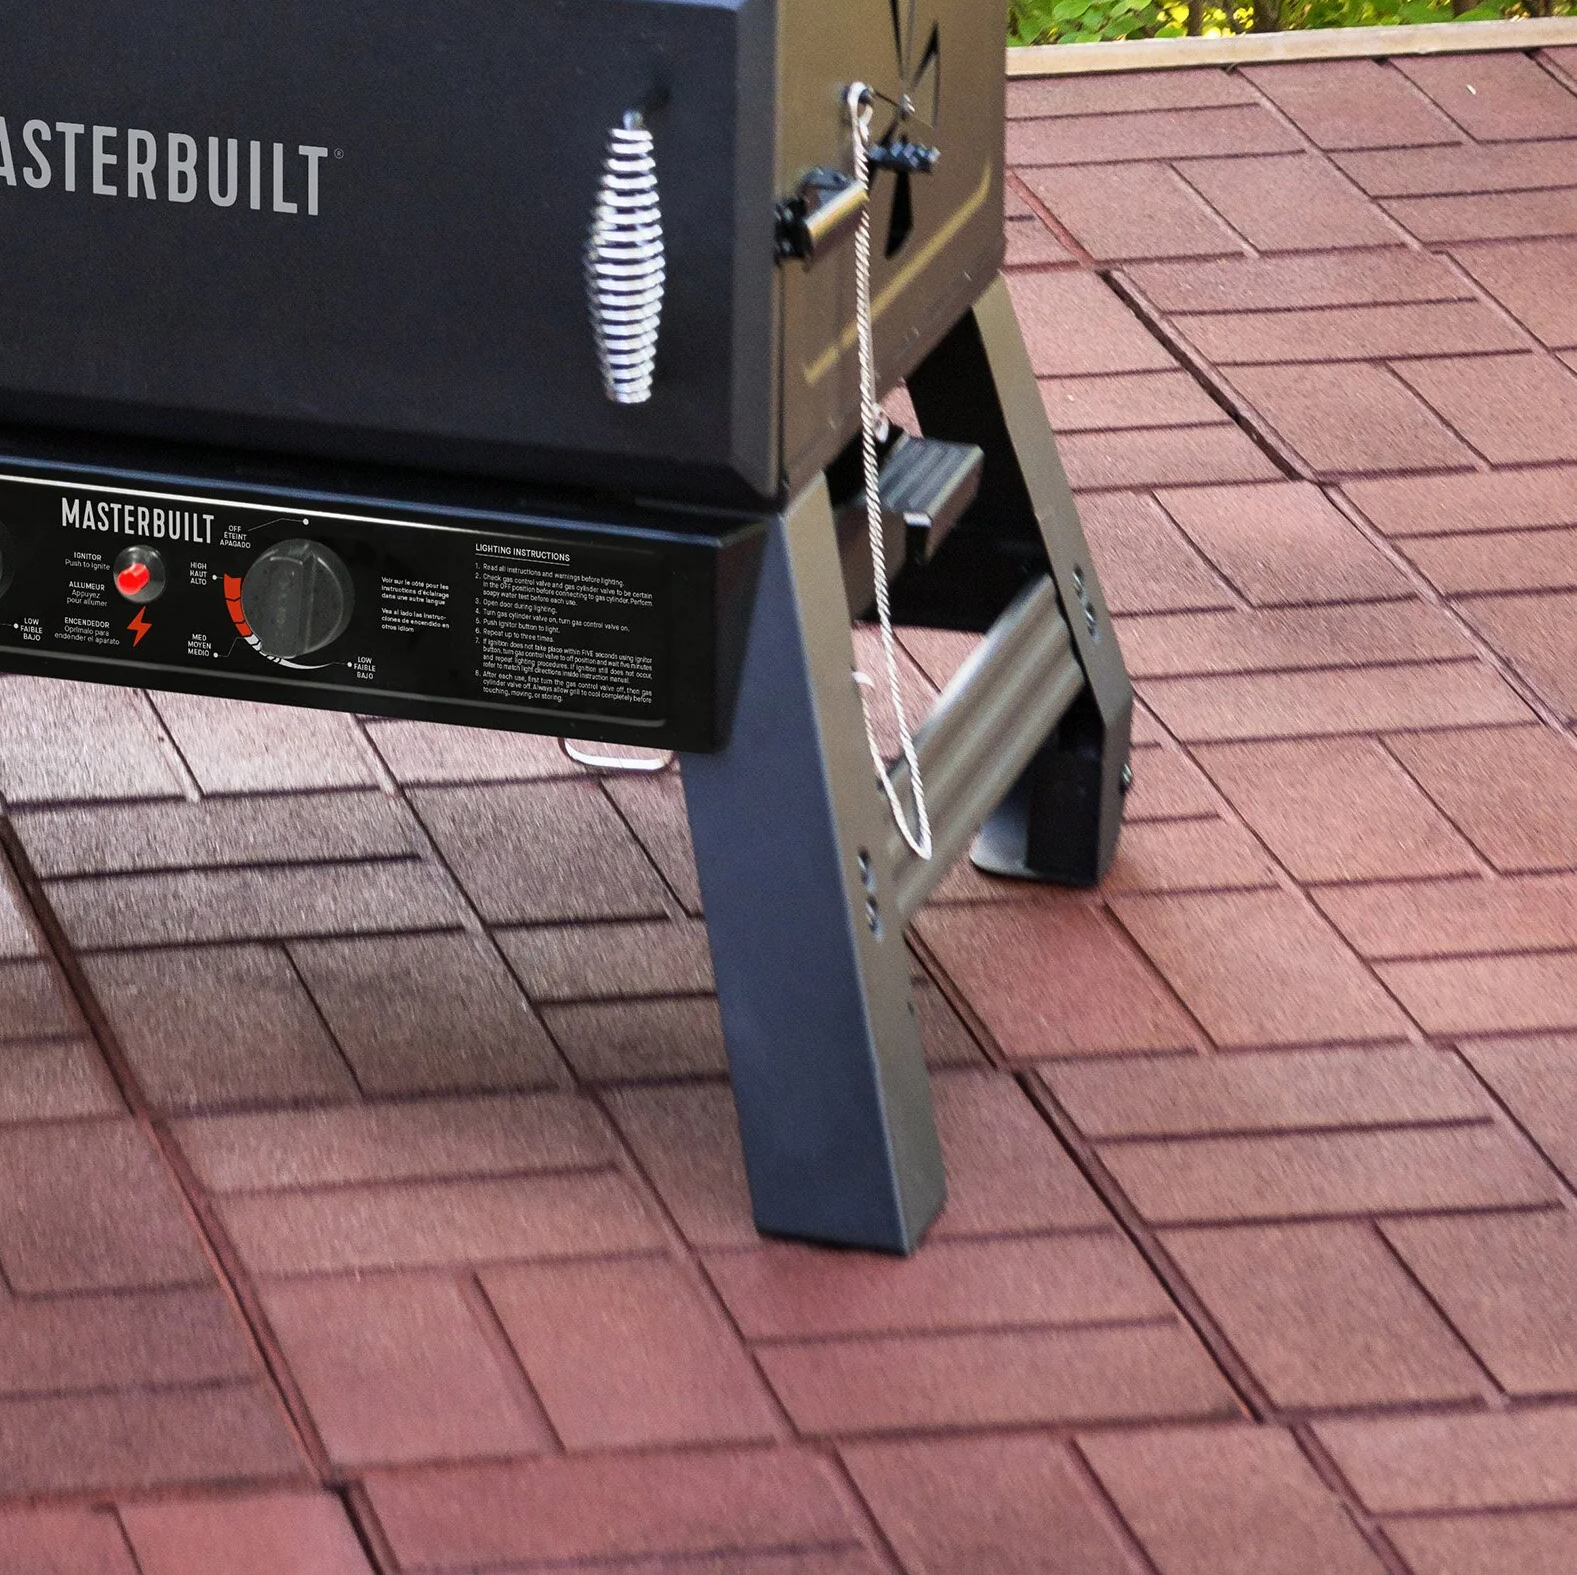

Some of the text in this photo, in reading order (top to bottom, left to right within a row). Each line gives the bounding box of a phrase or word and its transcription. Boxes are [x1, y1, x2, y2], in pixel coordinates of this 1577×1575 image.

[61, 497, 215, 544] MASTERBUILT
[220, 539, 251, 548] APAGADO
[74, 552, 102, 561] IGNITOR
[476, 543, 570, 562] LIGHTING INSTRUCTIONS
[65, 558, 82, 567] Push
[190, 570, 207, 578] HAUT
[483, 563, 498, 571] Read
[507, 566, 541, 577] instructions
[554, 573, 580, 583] warnings
[581, 575, 600, 584] before
[601, 577, 624, 588] lighting.
[69, 581, 105, 591] ALLUMEUR
[72, 589, 100, 600] Appuyez
[24, 617, 39, 625] LOW
[64, 617, 110, 628] ENCENDEDOR
[20, 625, 43, 634] FAIBLE
[23, 633, 41, 641] BAJO
[188, 641, 211, 649] MOYEN
[188, 648, 209, 656] MEDIO
[354, 663, 376, 672] FAIBLE
